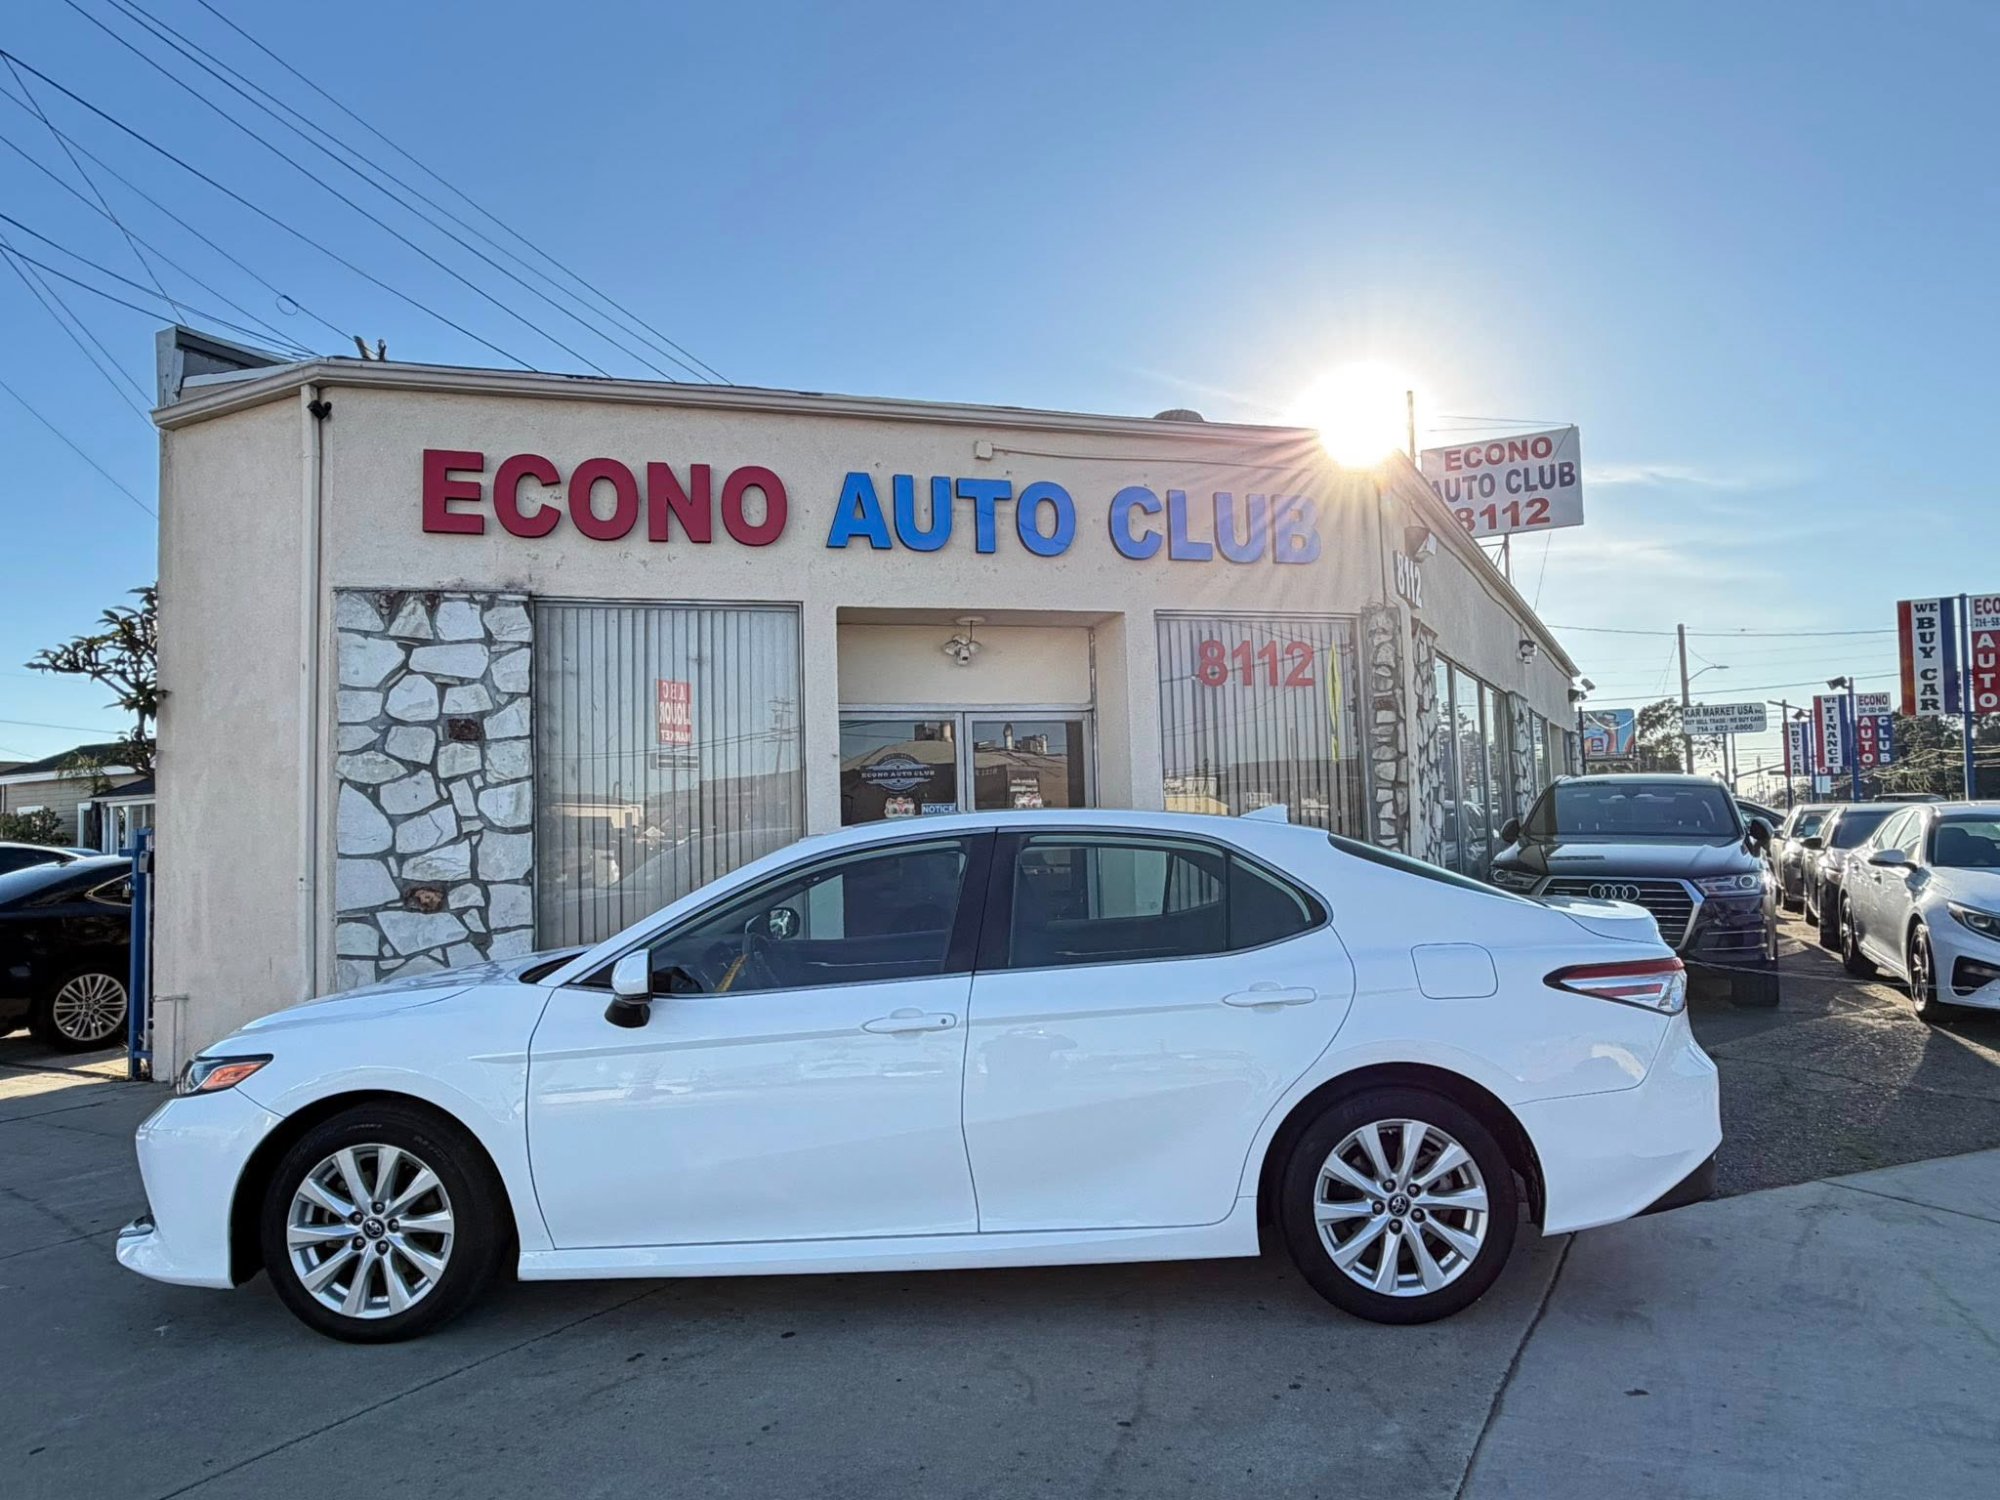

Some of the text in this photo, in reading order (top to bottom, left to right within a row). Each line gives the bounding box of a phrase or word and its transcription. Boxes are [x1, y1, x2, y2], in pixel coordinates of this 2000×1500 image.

[1445, 436, 1553, 472] ECONO
[1505, 461, 1576, 495] CLUB
[422, 448, 1323, 565] ECONO AUTO CLUB
[1454, 497, 1551, 532] 8112
[1397, 554, 1422, 609] 8112
[1198, 639, 1316, 688] 8112
[1914, 603, 1940, 711] WE BUY CAR
[1977, 633, 1998, 708] AUTO
[1684, 708, 1701, 718] KAR
[1702, 706, 1735, 716] MARKET
[1737, 705, 1753, 715] USA
[1859, 695, 1887, 706] ECONO
[1825, 707, 1838, 764] FINANCE
[1860, 717, 1873, 763] AUTO
[1877, 716, 1891, 763] CLUB
[922, 805, 954, 813] NOTICE
